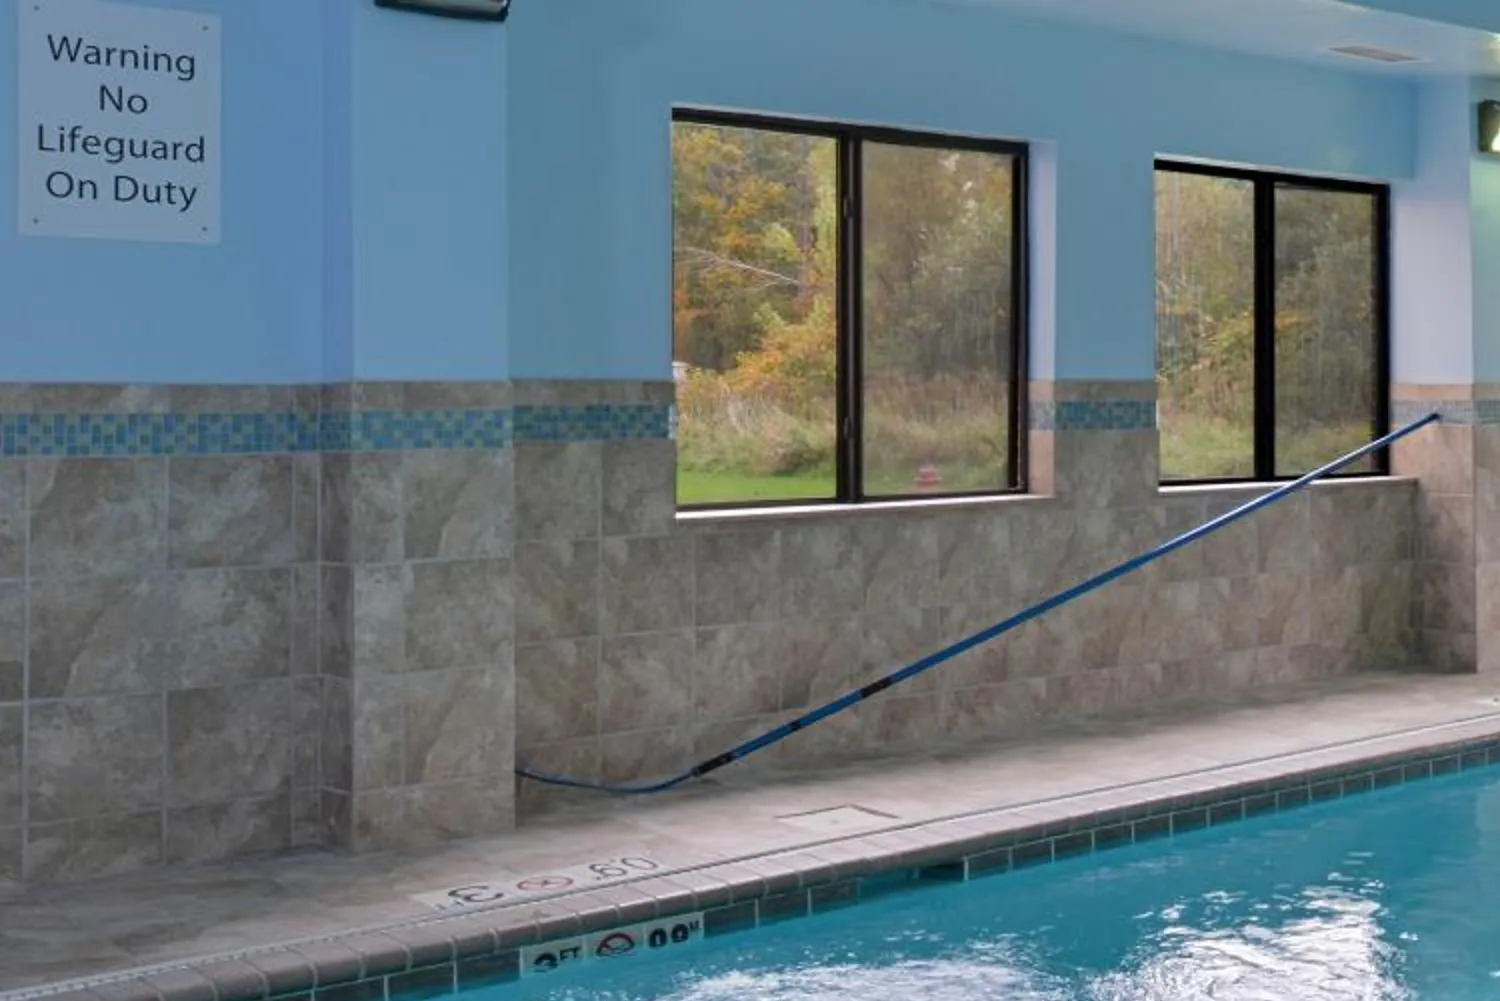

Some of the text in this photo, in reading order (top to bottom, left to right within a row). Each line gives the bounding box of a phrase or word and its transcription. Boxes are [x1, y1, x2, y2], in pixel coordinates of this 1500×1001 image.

[48, 34, 195, 81] Warning
[99, 84, 148, 114] No
[38, 124, 205, 164] Lifeguard
[46, 171, 197, 213] On Duty
